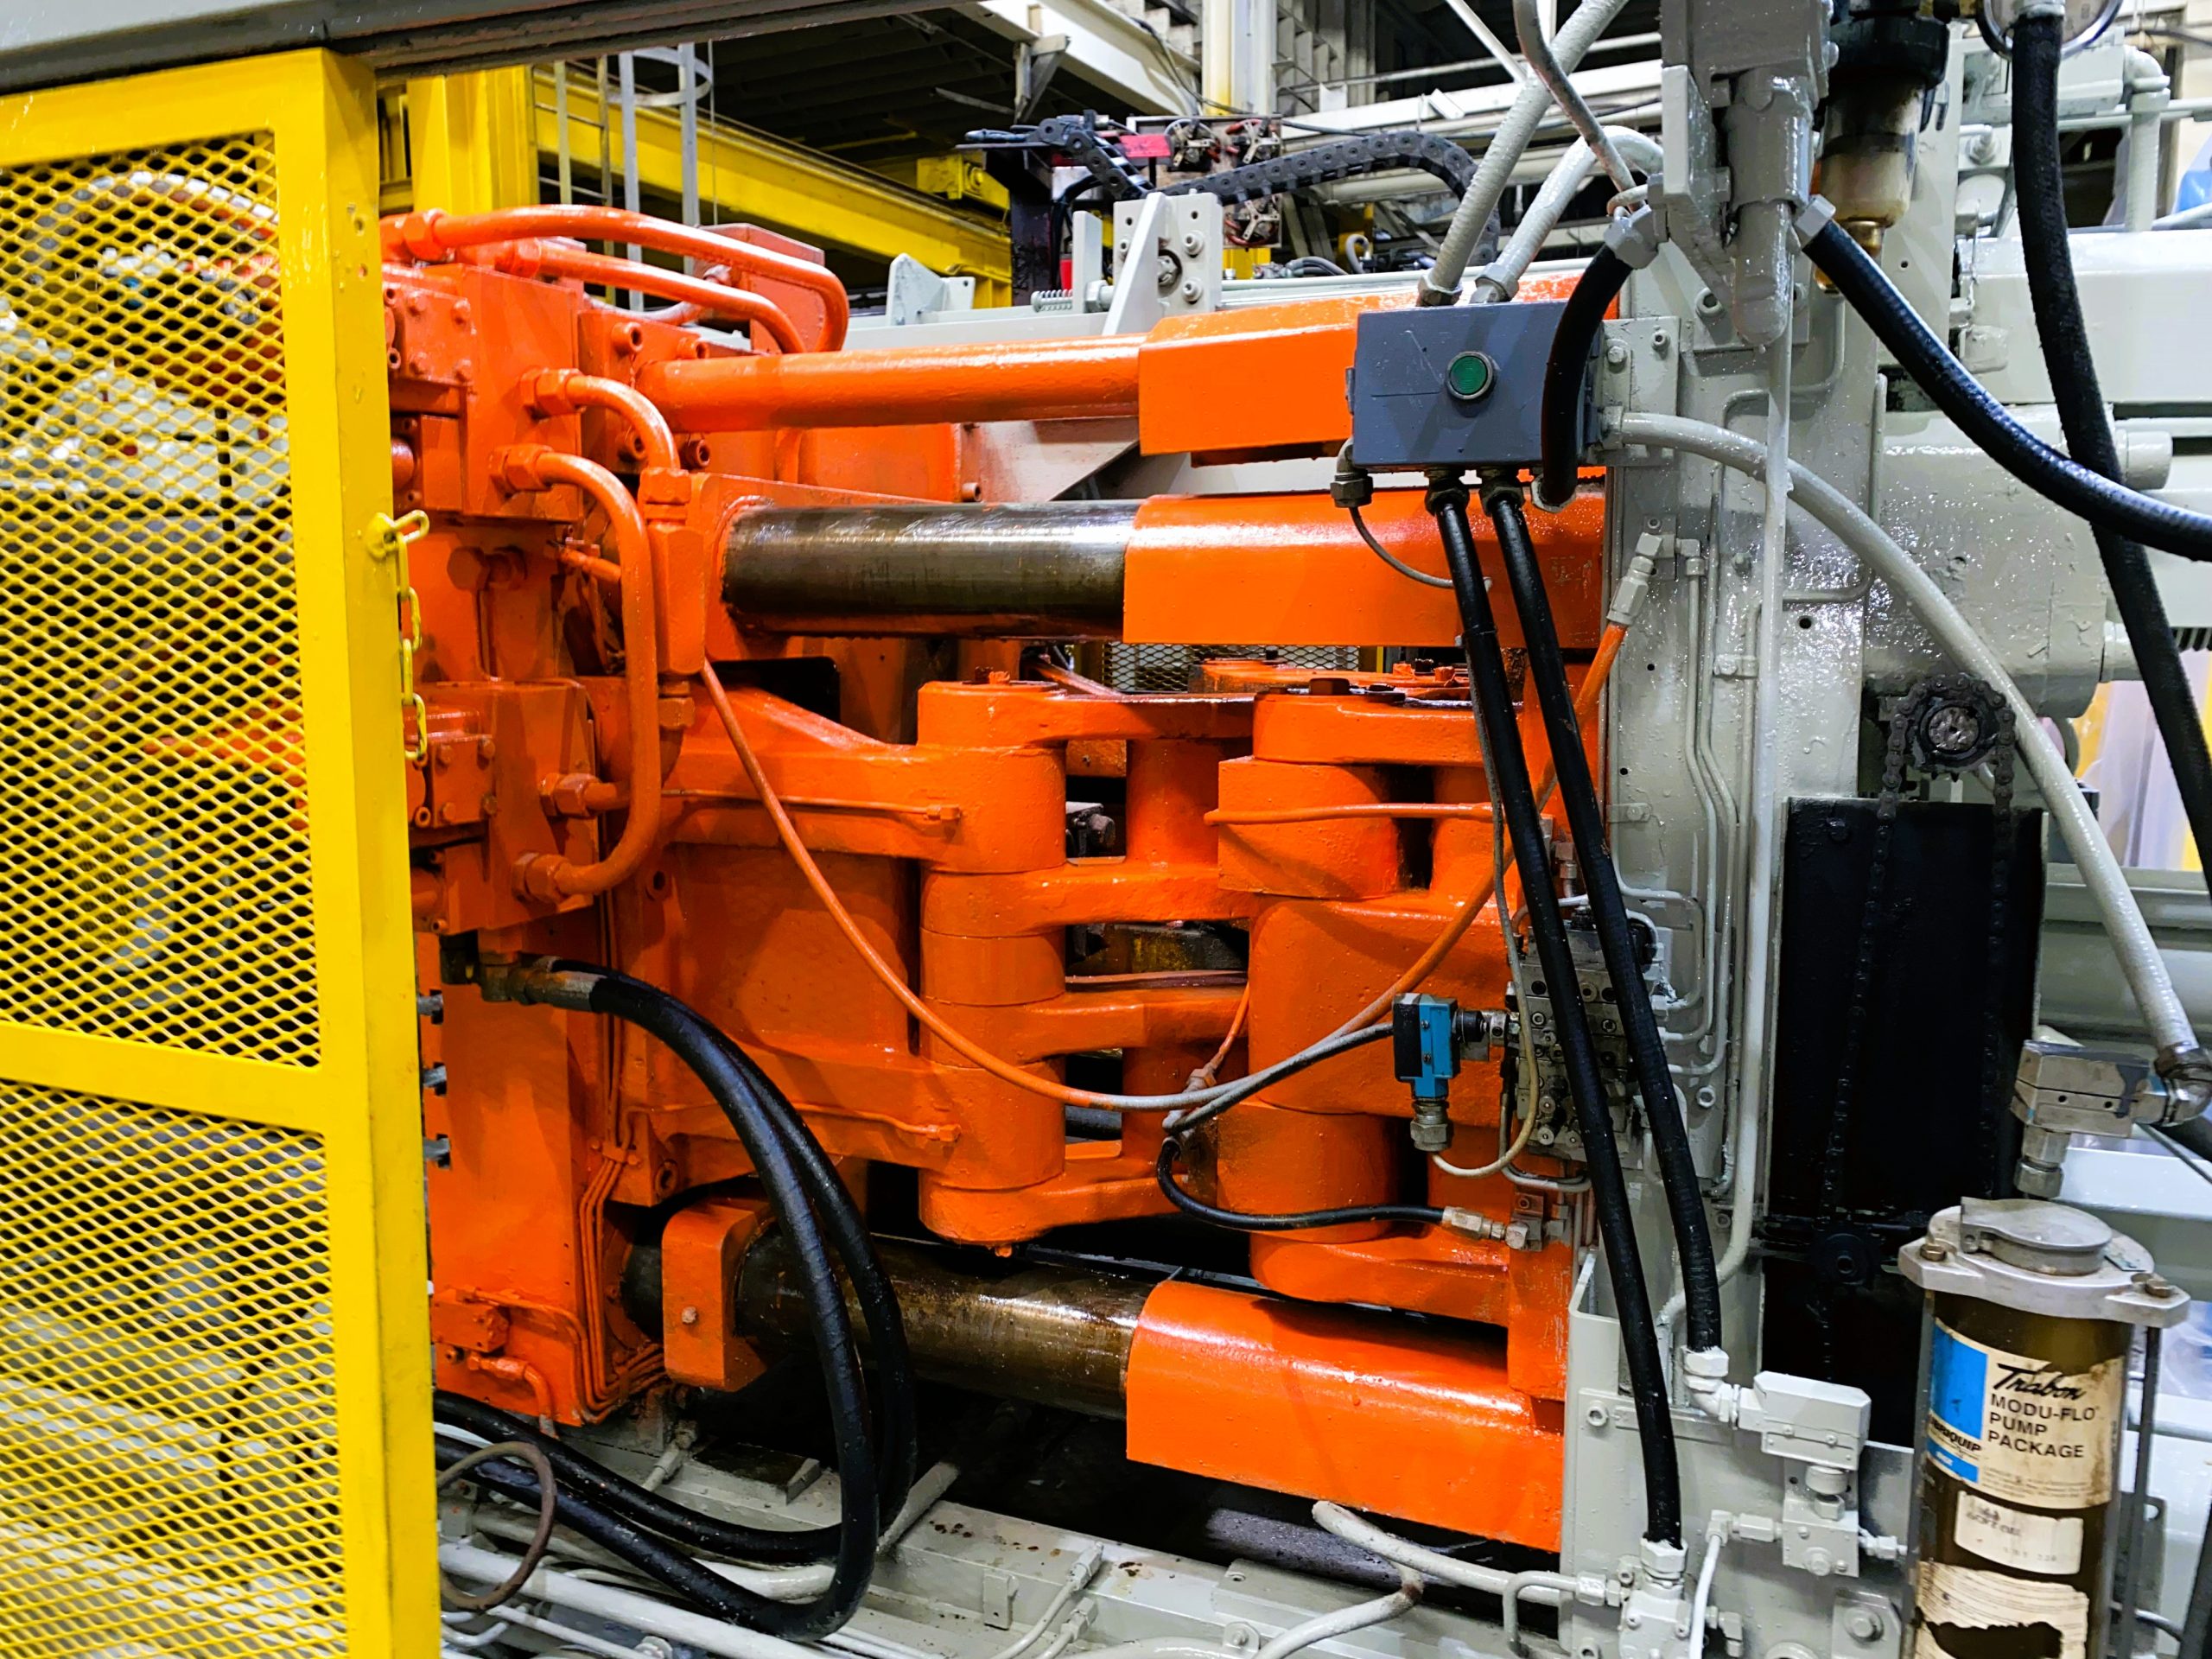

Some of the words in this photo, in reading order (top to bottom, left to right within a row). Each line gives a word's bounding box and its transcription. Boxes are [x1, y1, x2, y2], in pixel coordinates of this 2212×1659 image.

[1993, 1363, 2088, 1401] Trabon
[1990, 1393, 2097, 1421] MODU-FLO
[1989, 1411, 2048, 1436] PUMP
[1987, 1429, 2085, 1459] PACKAGE
